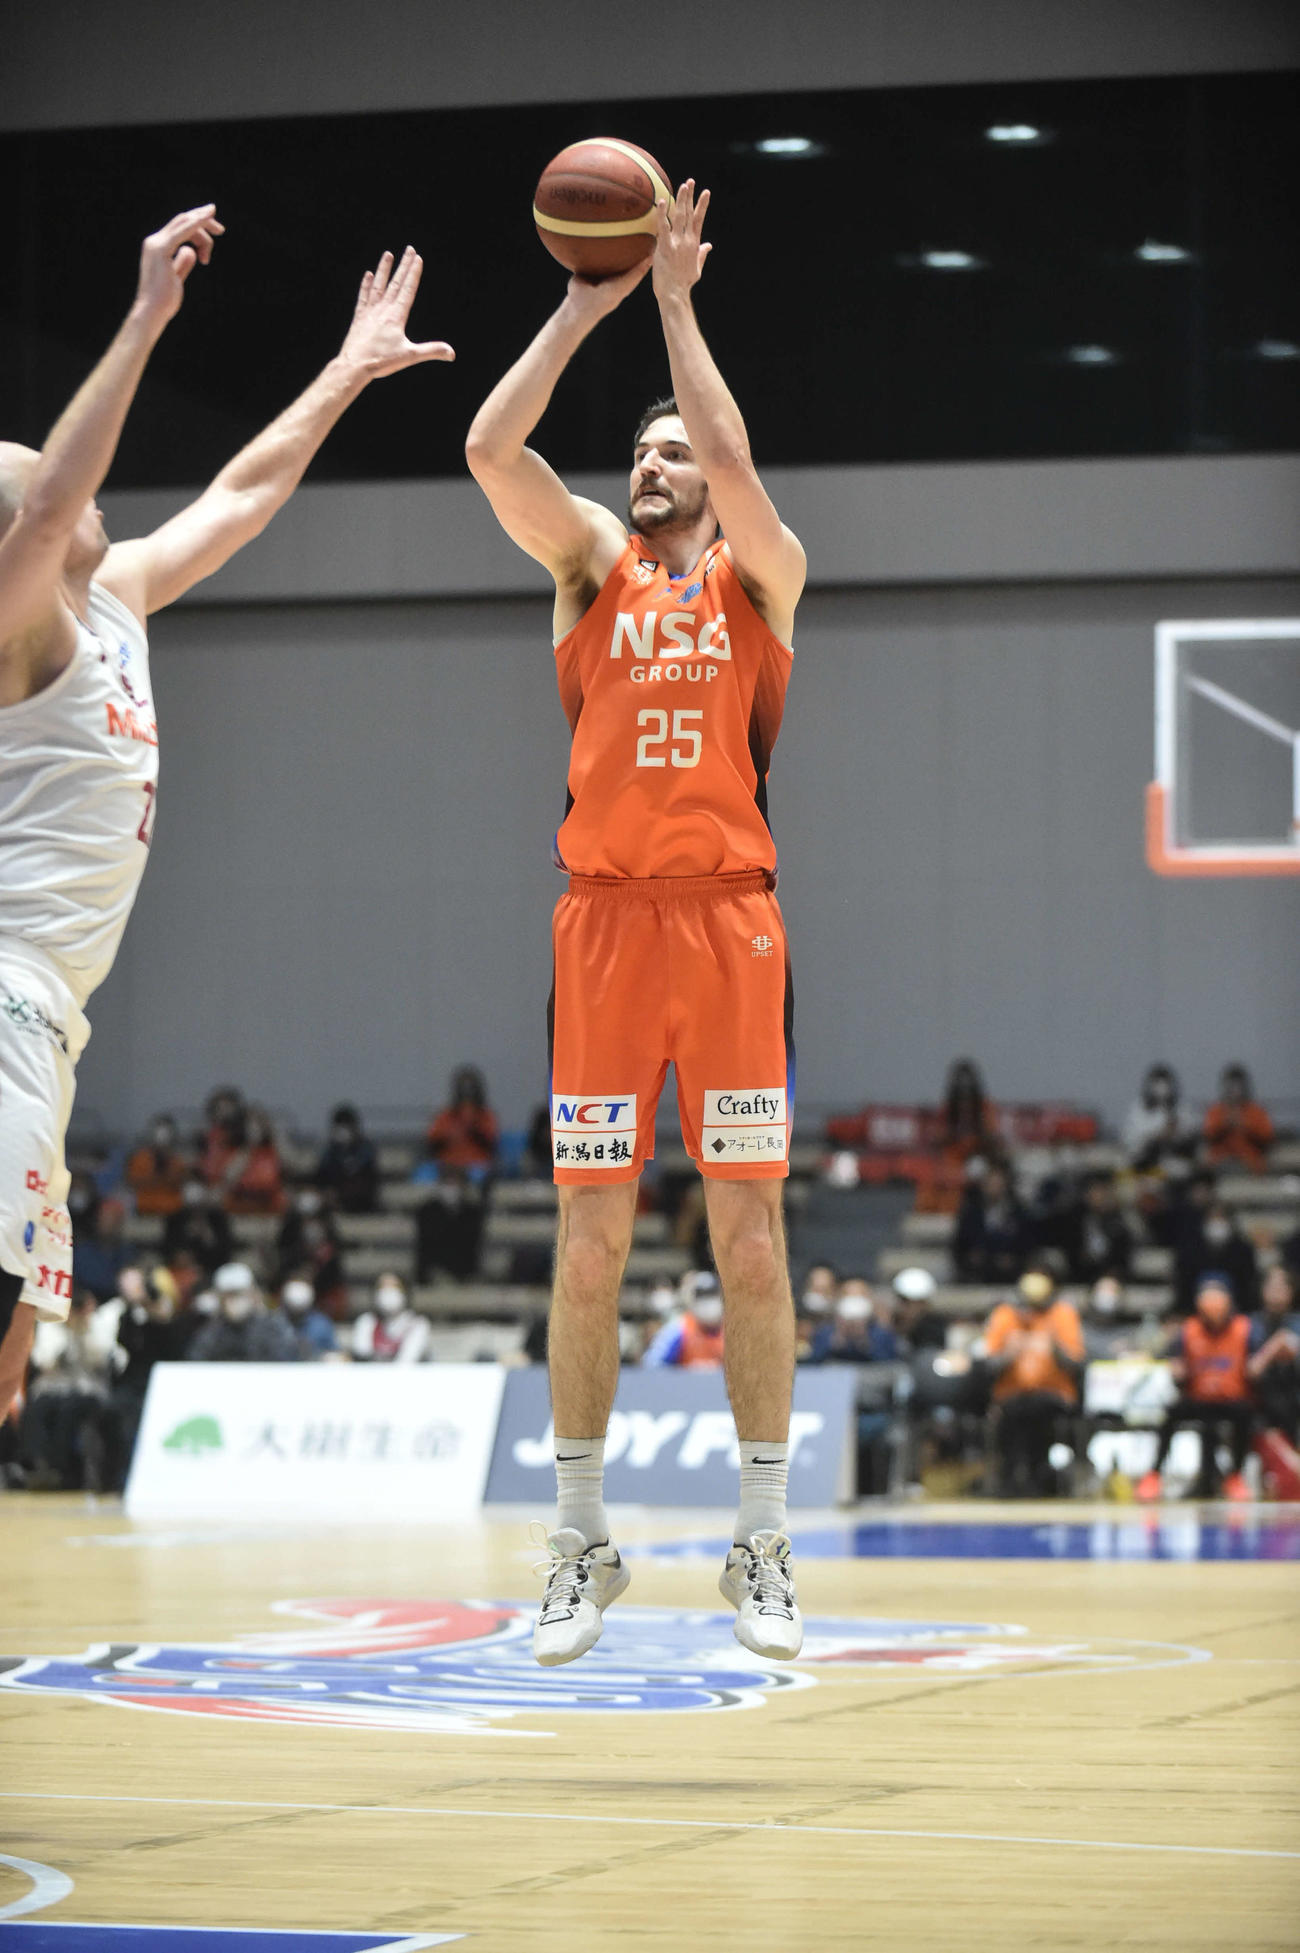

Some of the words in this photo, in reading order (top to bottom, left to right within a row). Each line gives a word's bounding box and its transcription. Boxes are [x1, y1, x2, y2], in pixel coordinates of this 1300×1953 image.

[610, 611, 732, 660] NSG
[630, 664, 719, 683] GROUP
[636, 709, 703, 768] 25
[557, 1103, 629, 1124] NCT
[717, 1094, 779, 1120] Crafty
[555, 1138, 632, 1162] 新潟日報
